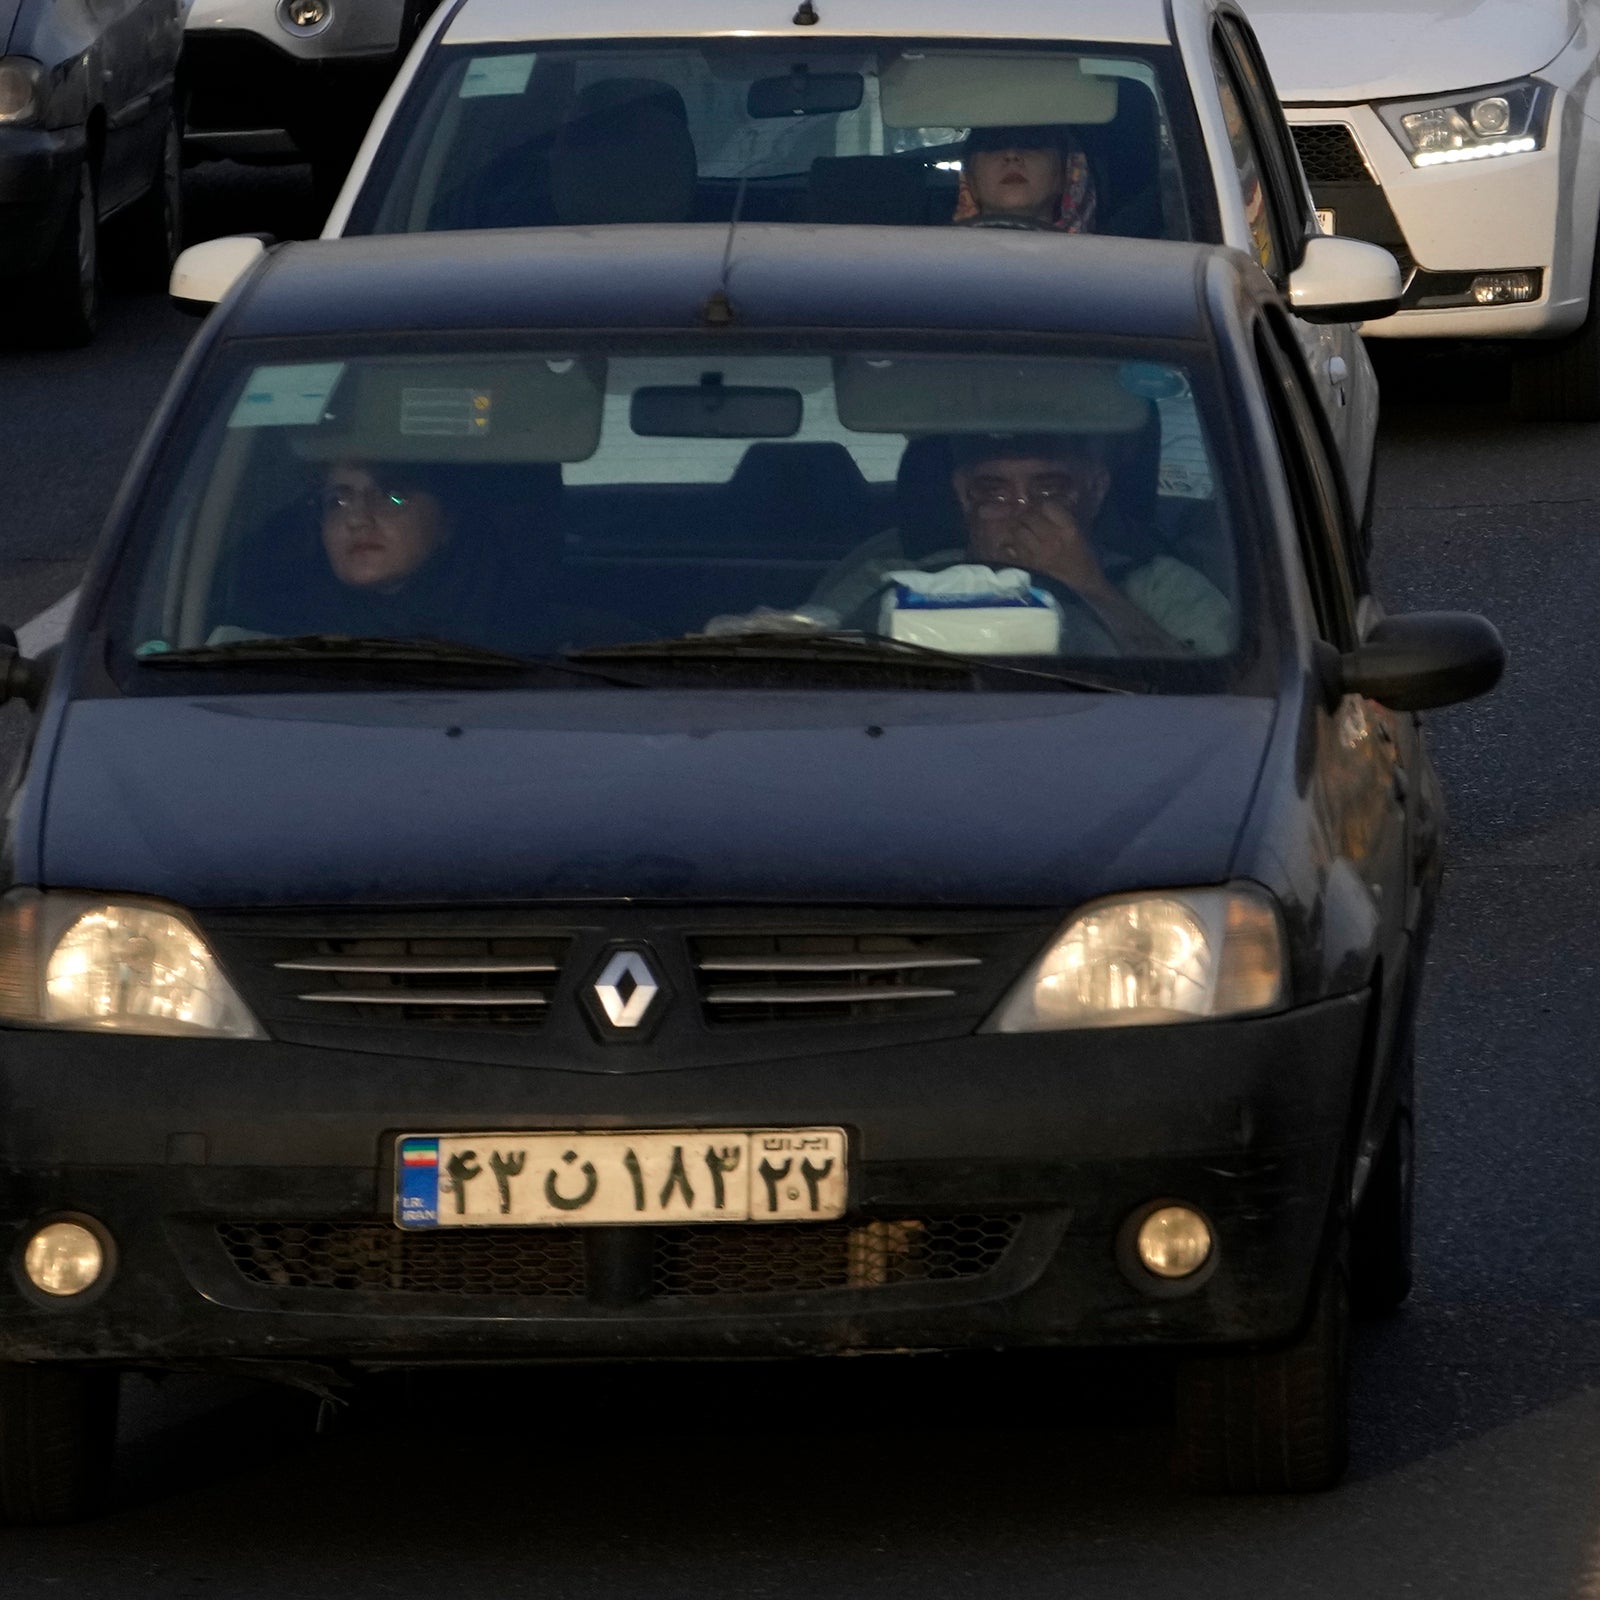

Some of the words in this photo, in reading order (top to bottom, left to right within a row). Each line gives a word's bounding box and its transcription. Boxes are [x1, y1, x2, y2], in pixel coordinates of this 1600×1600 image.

[762, 1137, 830, 1151] ایران
[446, 1150, 526, 1215] ۴۳
[544, 1149, 598, 1211] ن
[623, 1145, 741, 1212] ۱۸۳
[758, 1156, 835, 1212] ۲۲
[402, 1210, 437, 1221] IRAN
